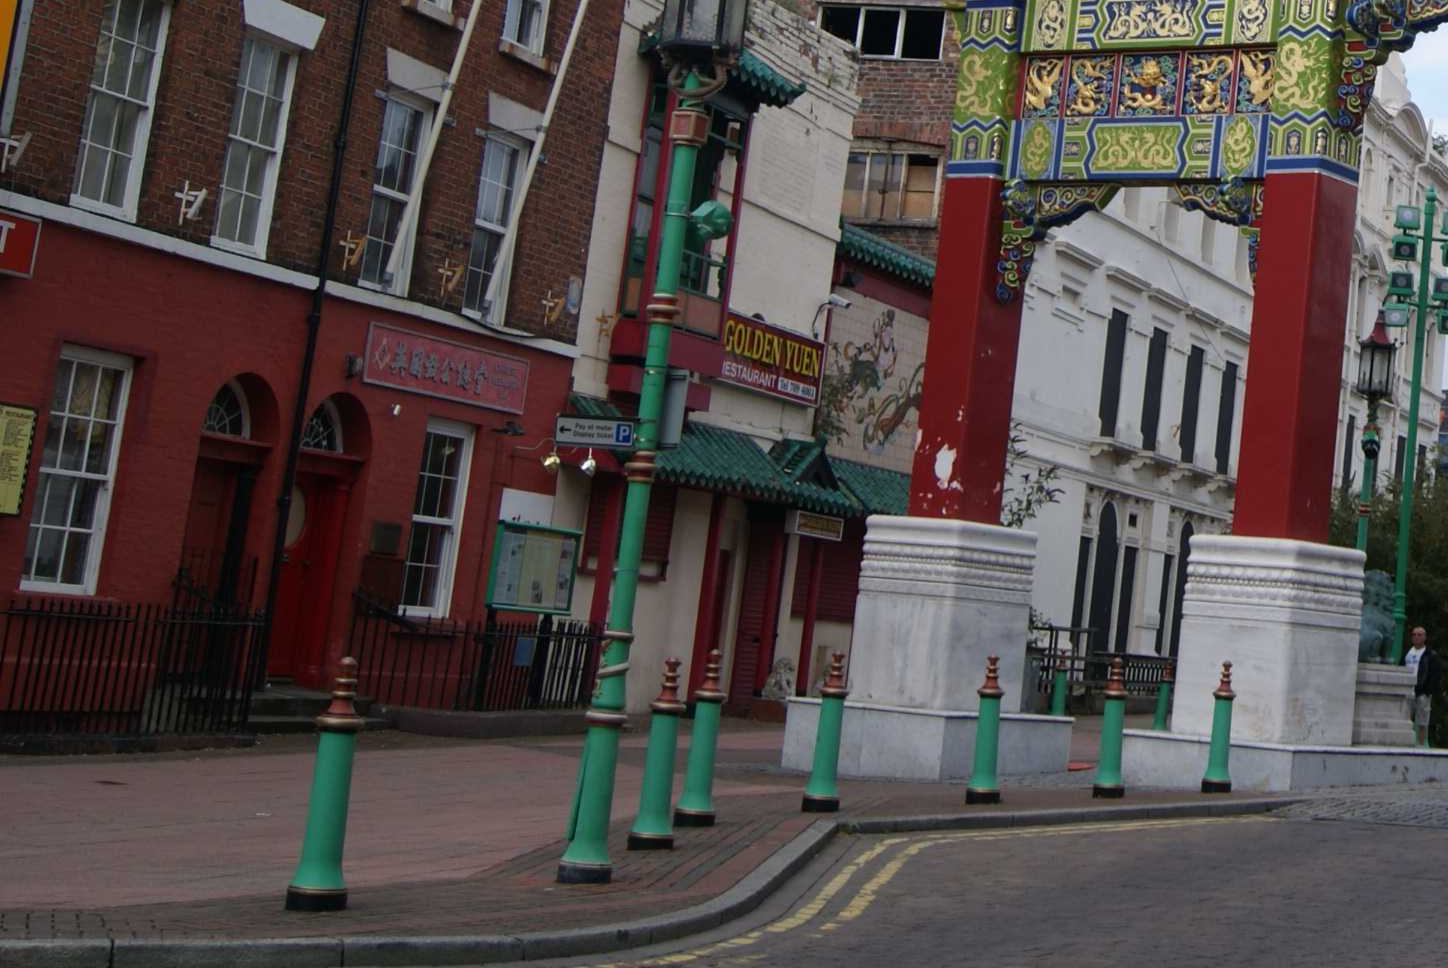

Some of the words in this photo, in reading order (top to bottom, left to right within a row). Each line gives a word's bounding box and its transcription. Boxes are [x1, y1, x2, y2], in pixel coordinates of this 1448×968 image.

[724, 320, 783, 367] GOLDEN
[785, 340, 822, 378] YUEN
[619, 426, 630, 441] P
